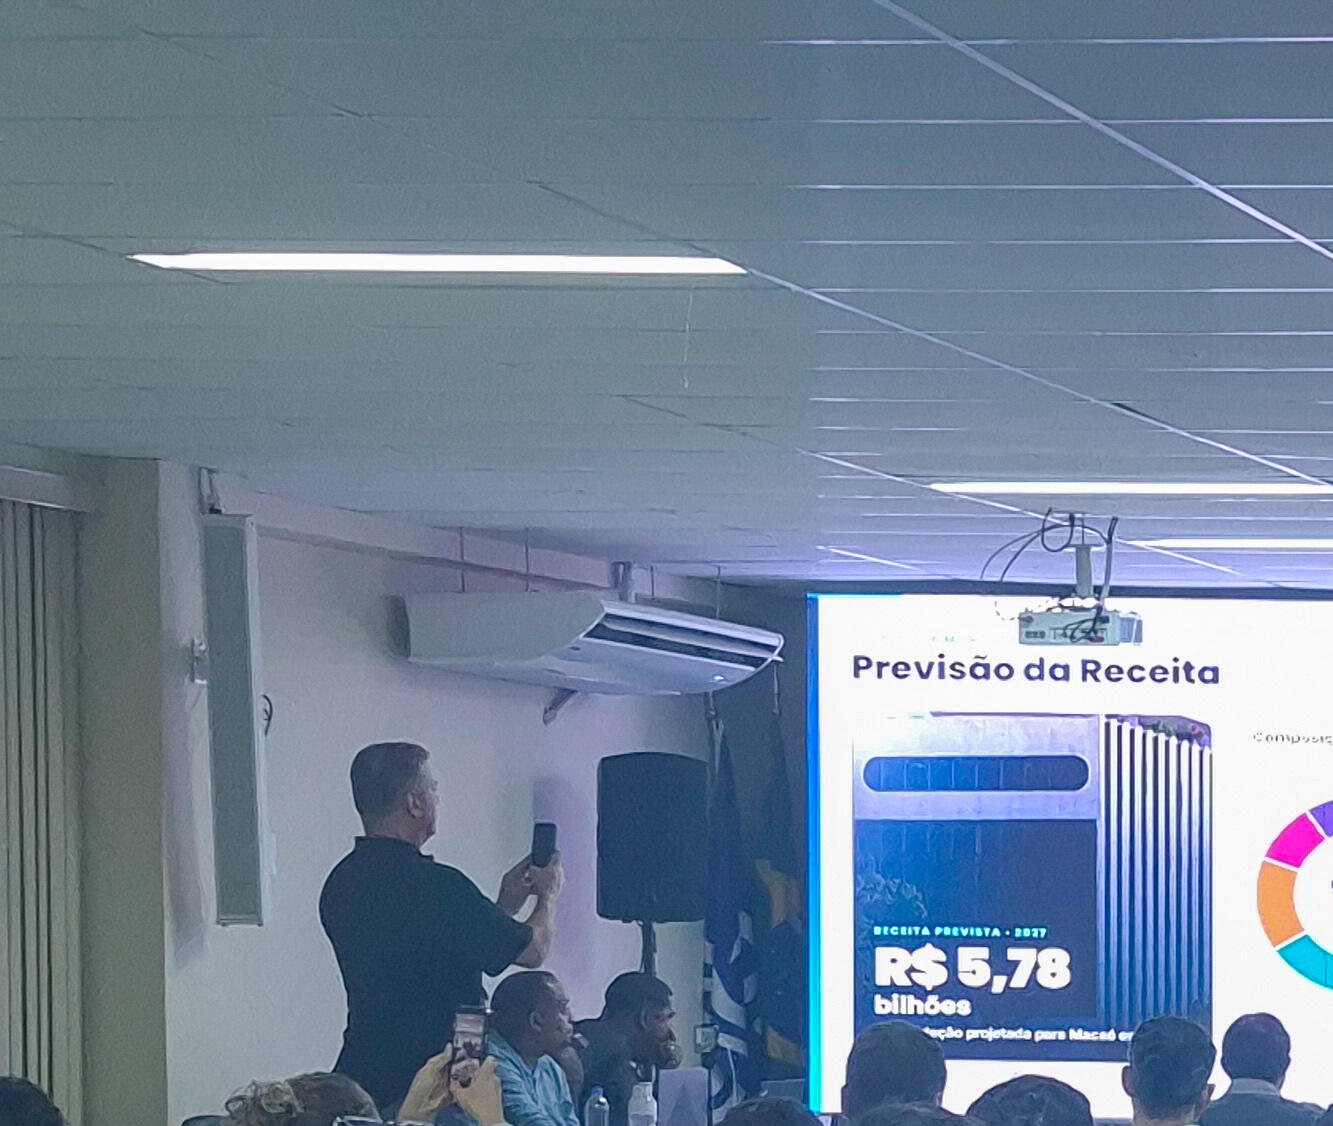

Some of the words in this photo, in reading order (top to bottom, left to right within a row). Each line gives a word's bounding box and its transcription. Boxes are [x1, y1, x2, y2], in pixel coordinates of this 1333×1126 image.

[853, 652, 1015, 682] Previsão
[1023, 656, 1071, 683] da
[1080, 656, 1220, 685] Receita
[873, 926, 931, 936] RECEITA
[934, 926, 1001, 937] PREVISTA
[875, 943, 948, 991] R$
[957, 946, 1071, 994] 5,78
[874, 993, 972, 1016] bilhões
